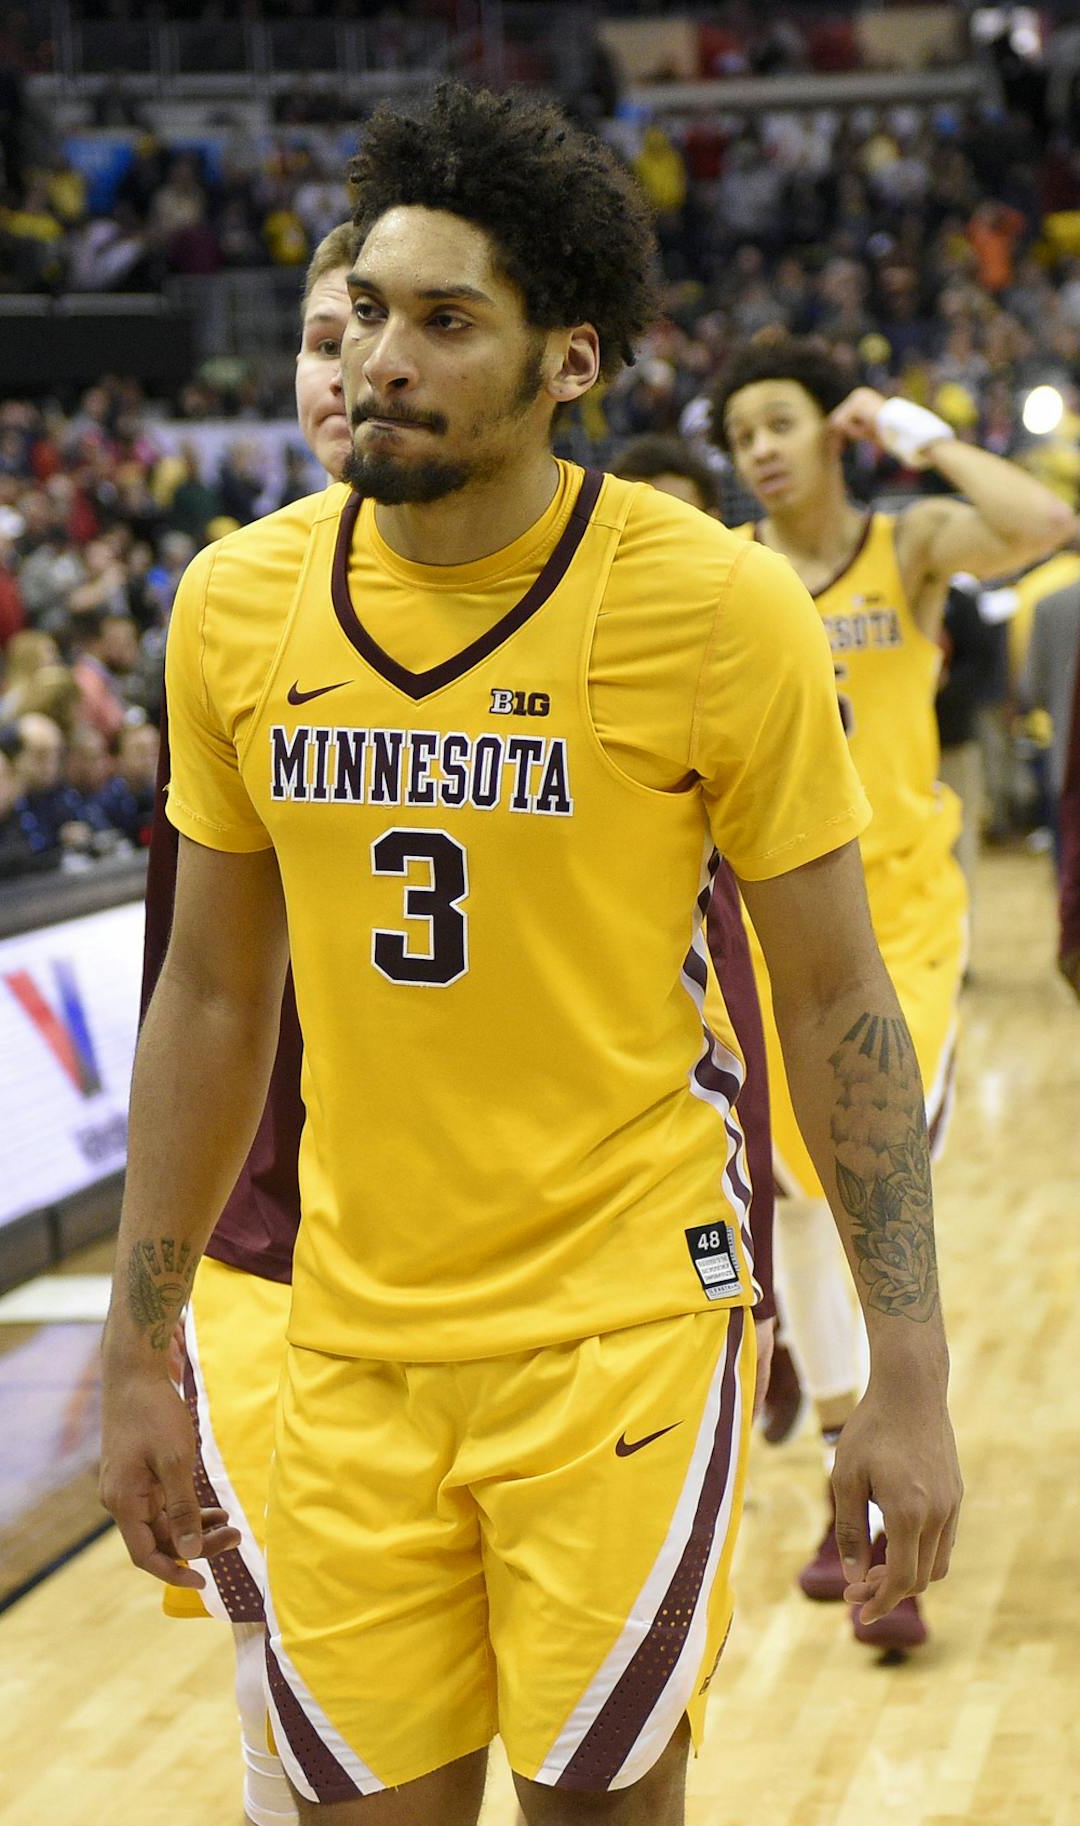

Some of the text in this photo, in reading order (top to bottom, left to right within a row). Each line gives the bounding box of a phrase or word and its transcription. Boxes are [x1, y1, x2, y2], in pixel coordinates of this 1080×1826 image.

[270, 725, 574, 816] MINNESOTA
[370, 827, 469, 987] 3
[698, 1230, 720, 1250] 48
